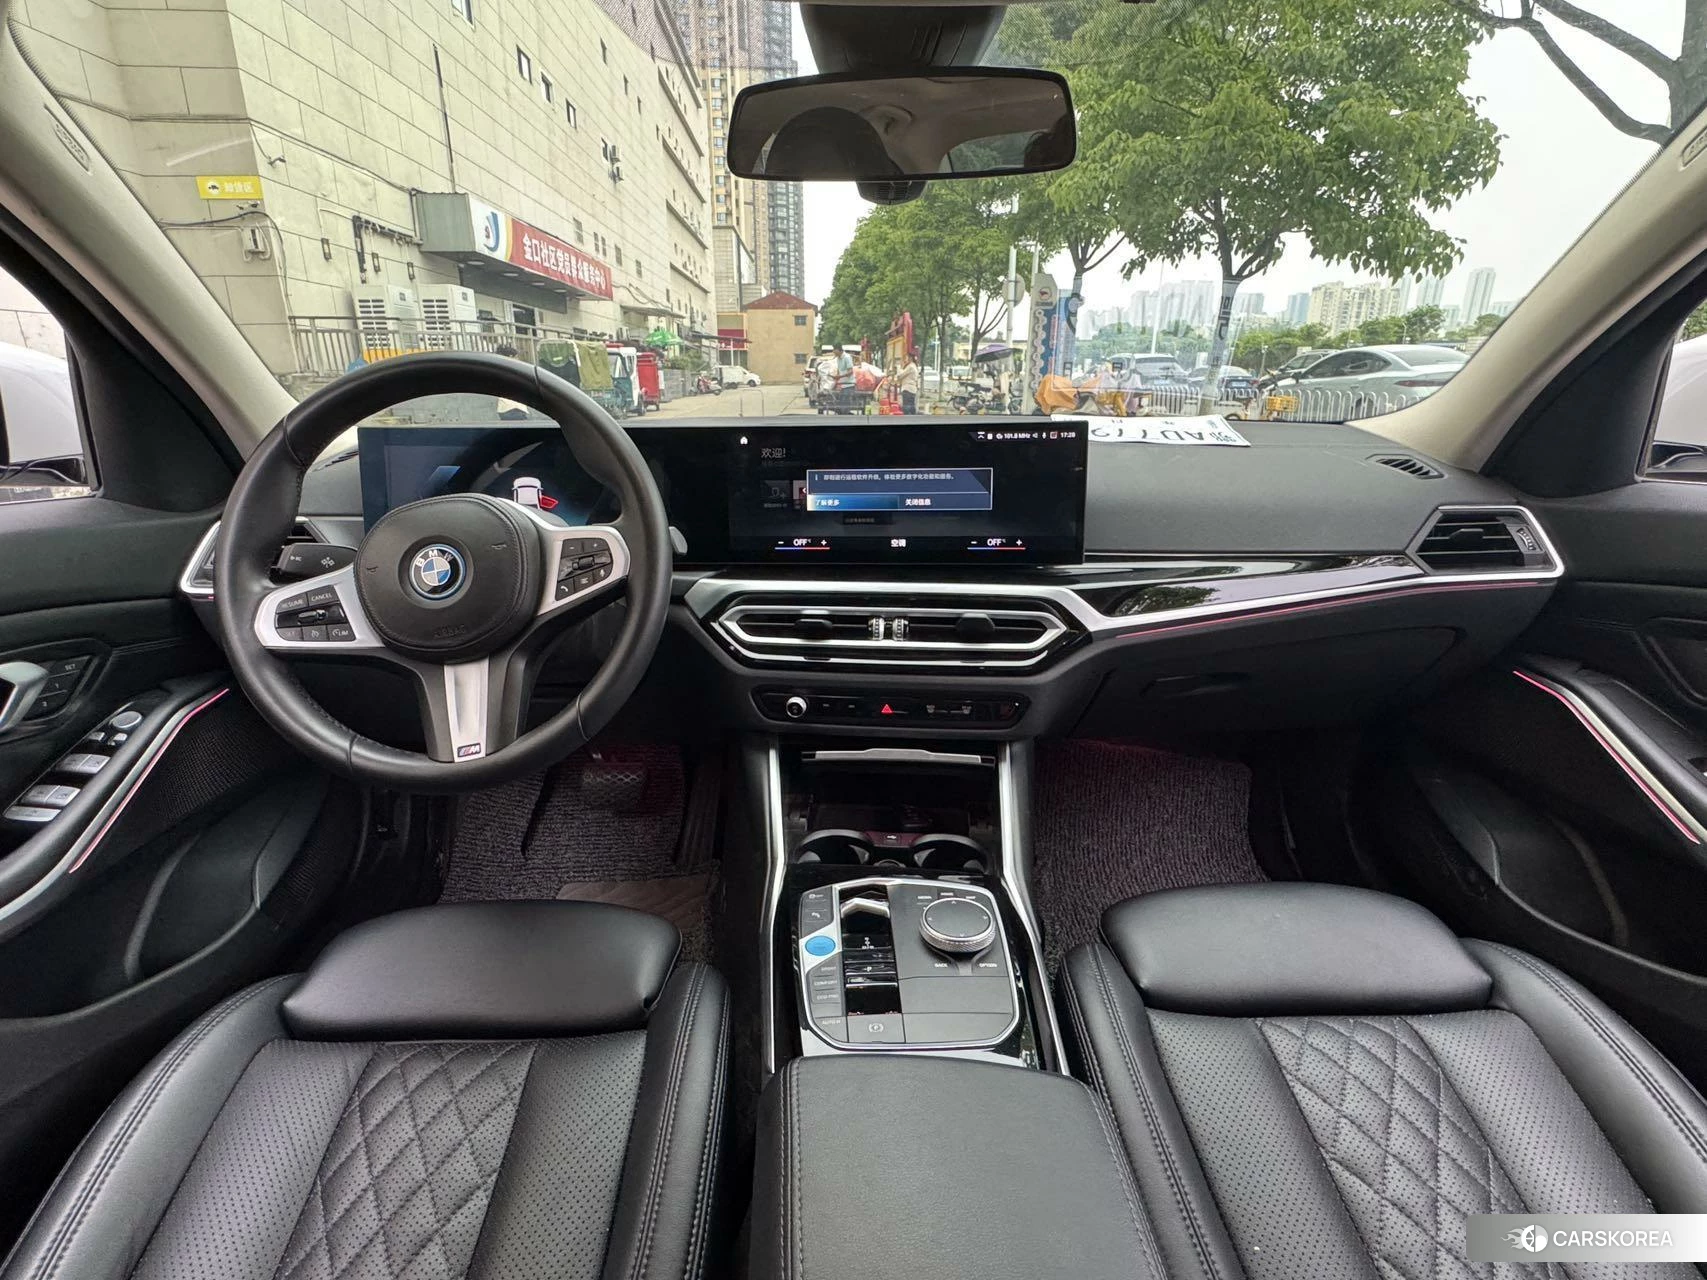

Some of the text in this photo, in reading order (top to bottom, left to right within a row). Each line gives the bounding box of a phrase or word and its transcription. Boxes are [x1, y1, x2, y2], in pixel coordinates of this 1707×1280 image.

[793, 538, 807, 546] OFF
[891, 539, 906, 547] 空调
[987, 538, 1001, 546] OFF
[415, 549, 454, 567] BMW
[311, 592, 333, 602] CANCEL
